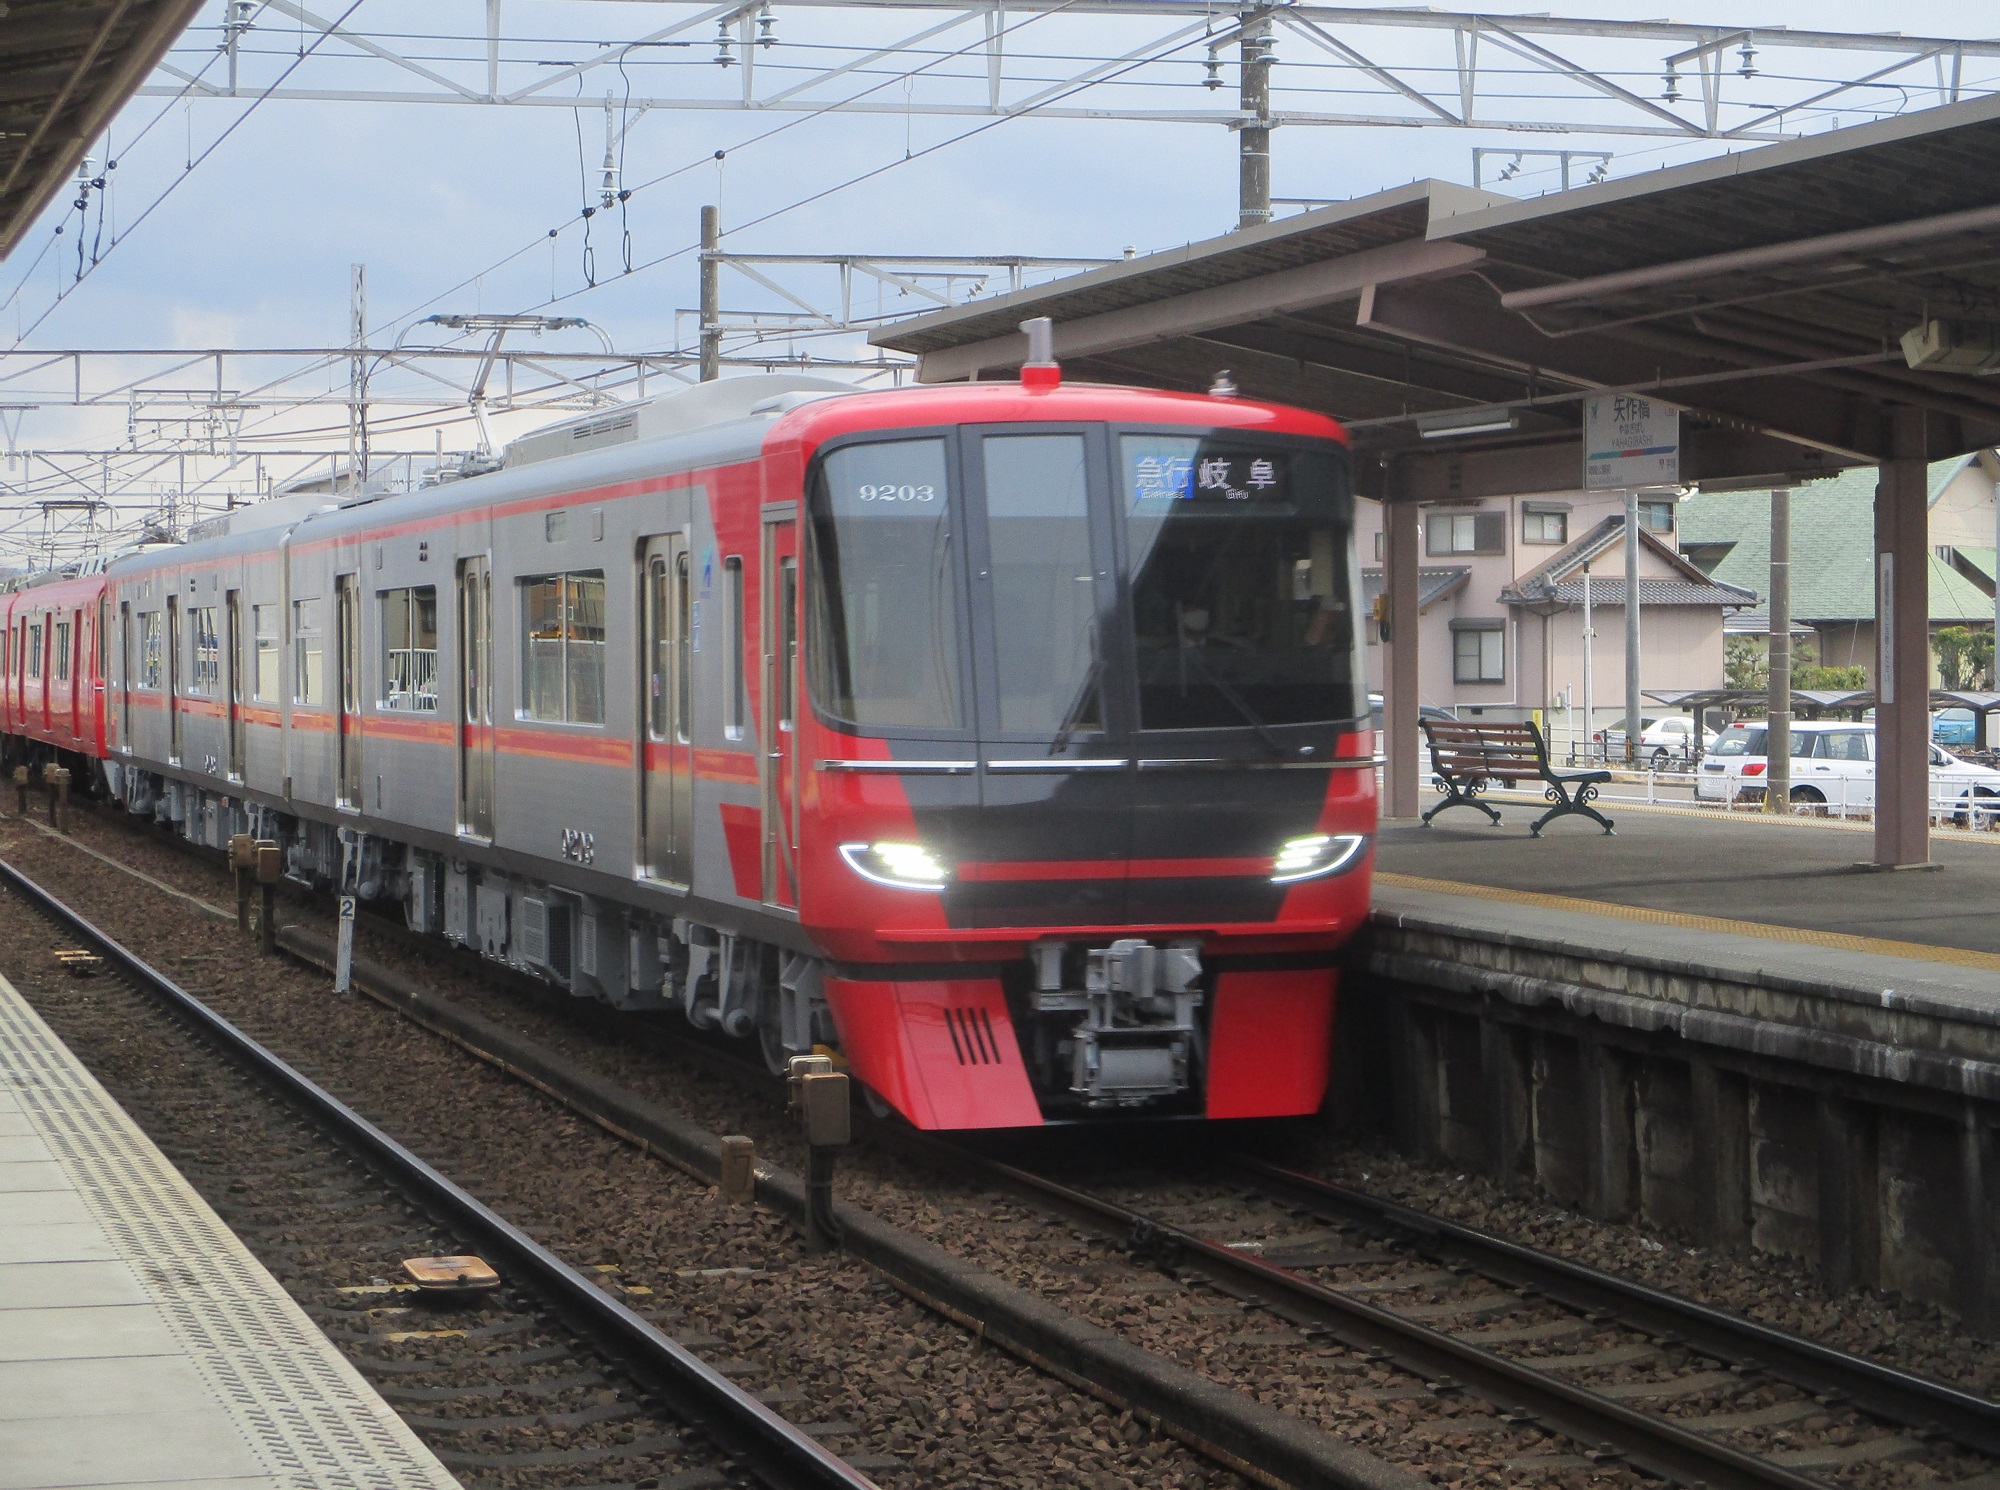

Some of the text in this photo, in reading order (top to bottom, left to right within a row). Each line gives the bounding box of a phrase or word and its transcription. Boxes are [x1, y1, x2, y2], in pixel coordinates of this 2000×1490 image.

[1613, 396, 1651, 422] 矢作橋
[1611, 434, 1654, 449] YAHAGIBASHI
[1136, 456, 1277, 490] 急行 岐阜
[859, 484, 935, 502] 9203
[341, 899, 354, 917] 2
